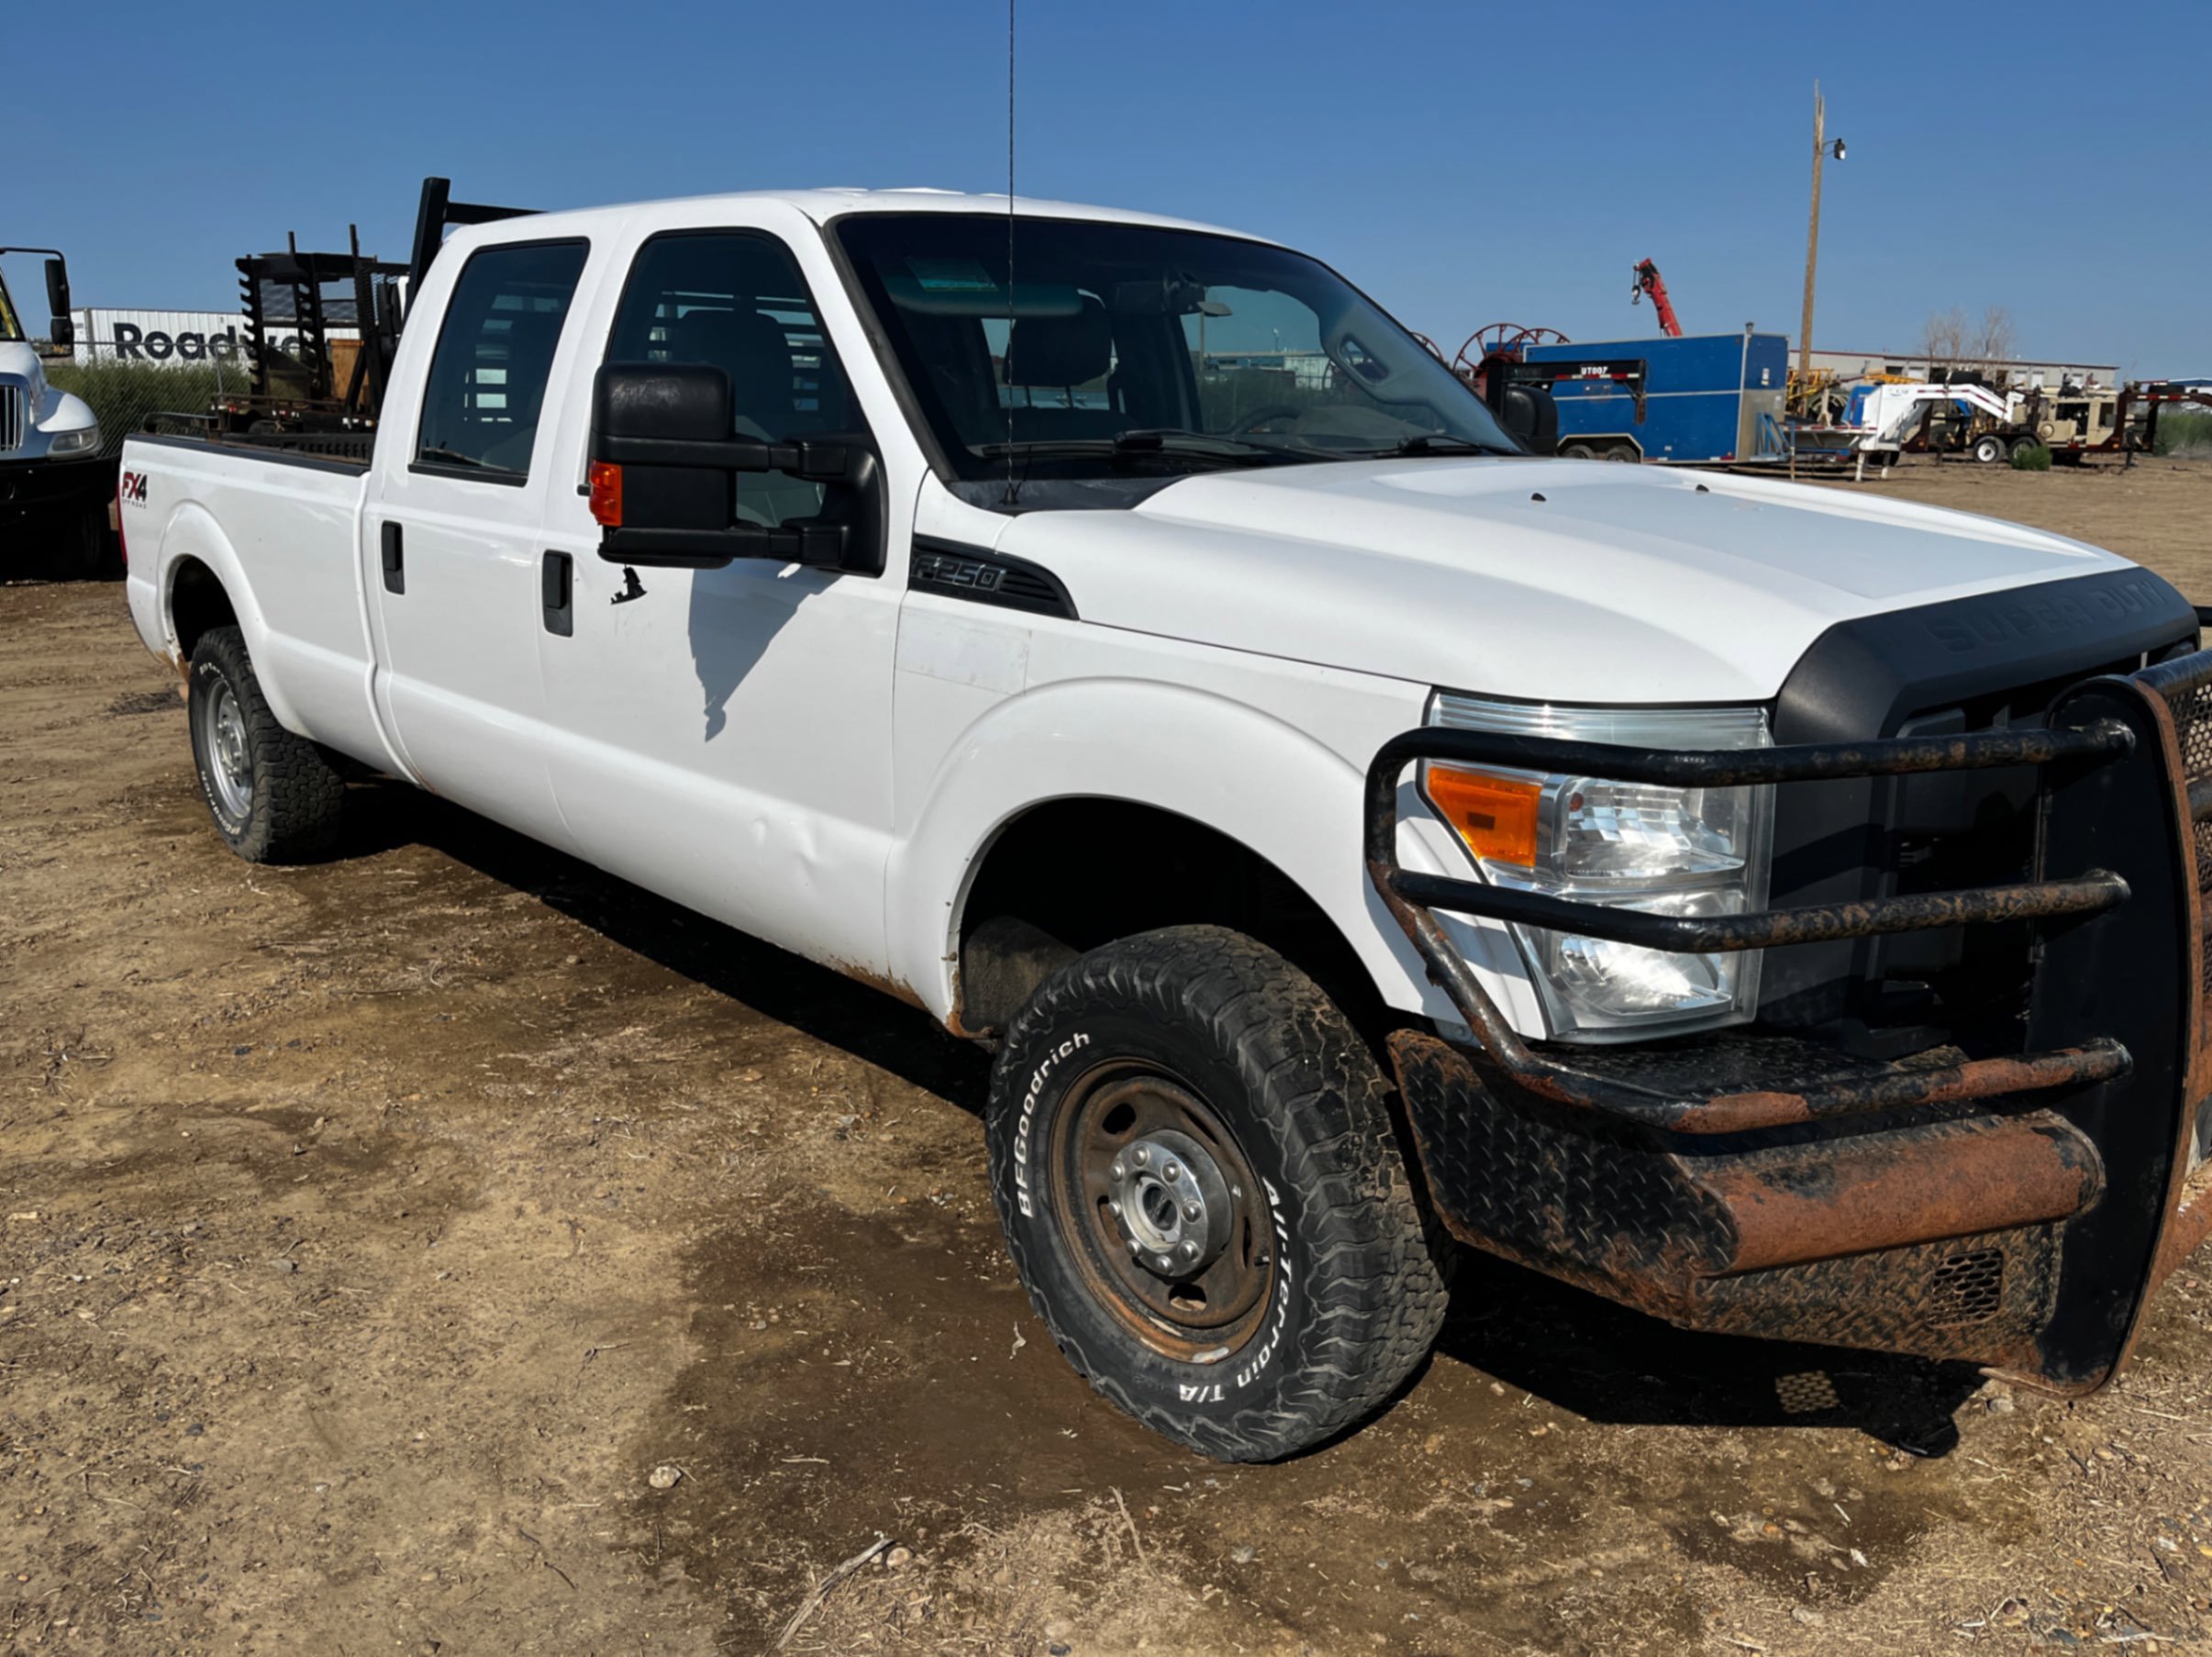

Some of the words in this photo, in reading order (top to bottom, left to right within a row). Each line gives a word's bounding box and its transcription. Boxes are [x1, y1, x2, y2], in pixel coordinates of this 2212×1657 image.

[122, 472, 148, 502] FX4
[1924, 596, 2095, 655] SUPER
[2088, 580, 2167, 620] DUTY
[1014, 1032, 1090, 1218] BFGoodrich
[1237, 1176, 1292, 1388] All-Terrain
[1179, 1383, 1226, 1404] T/A
